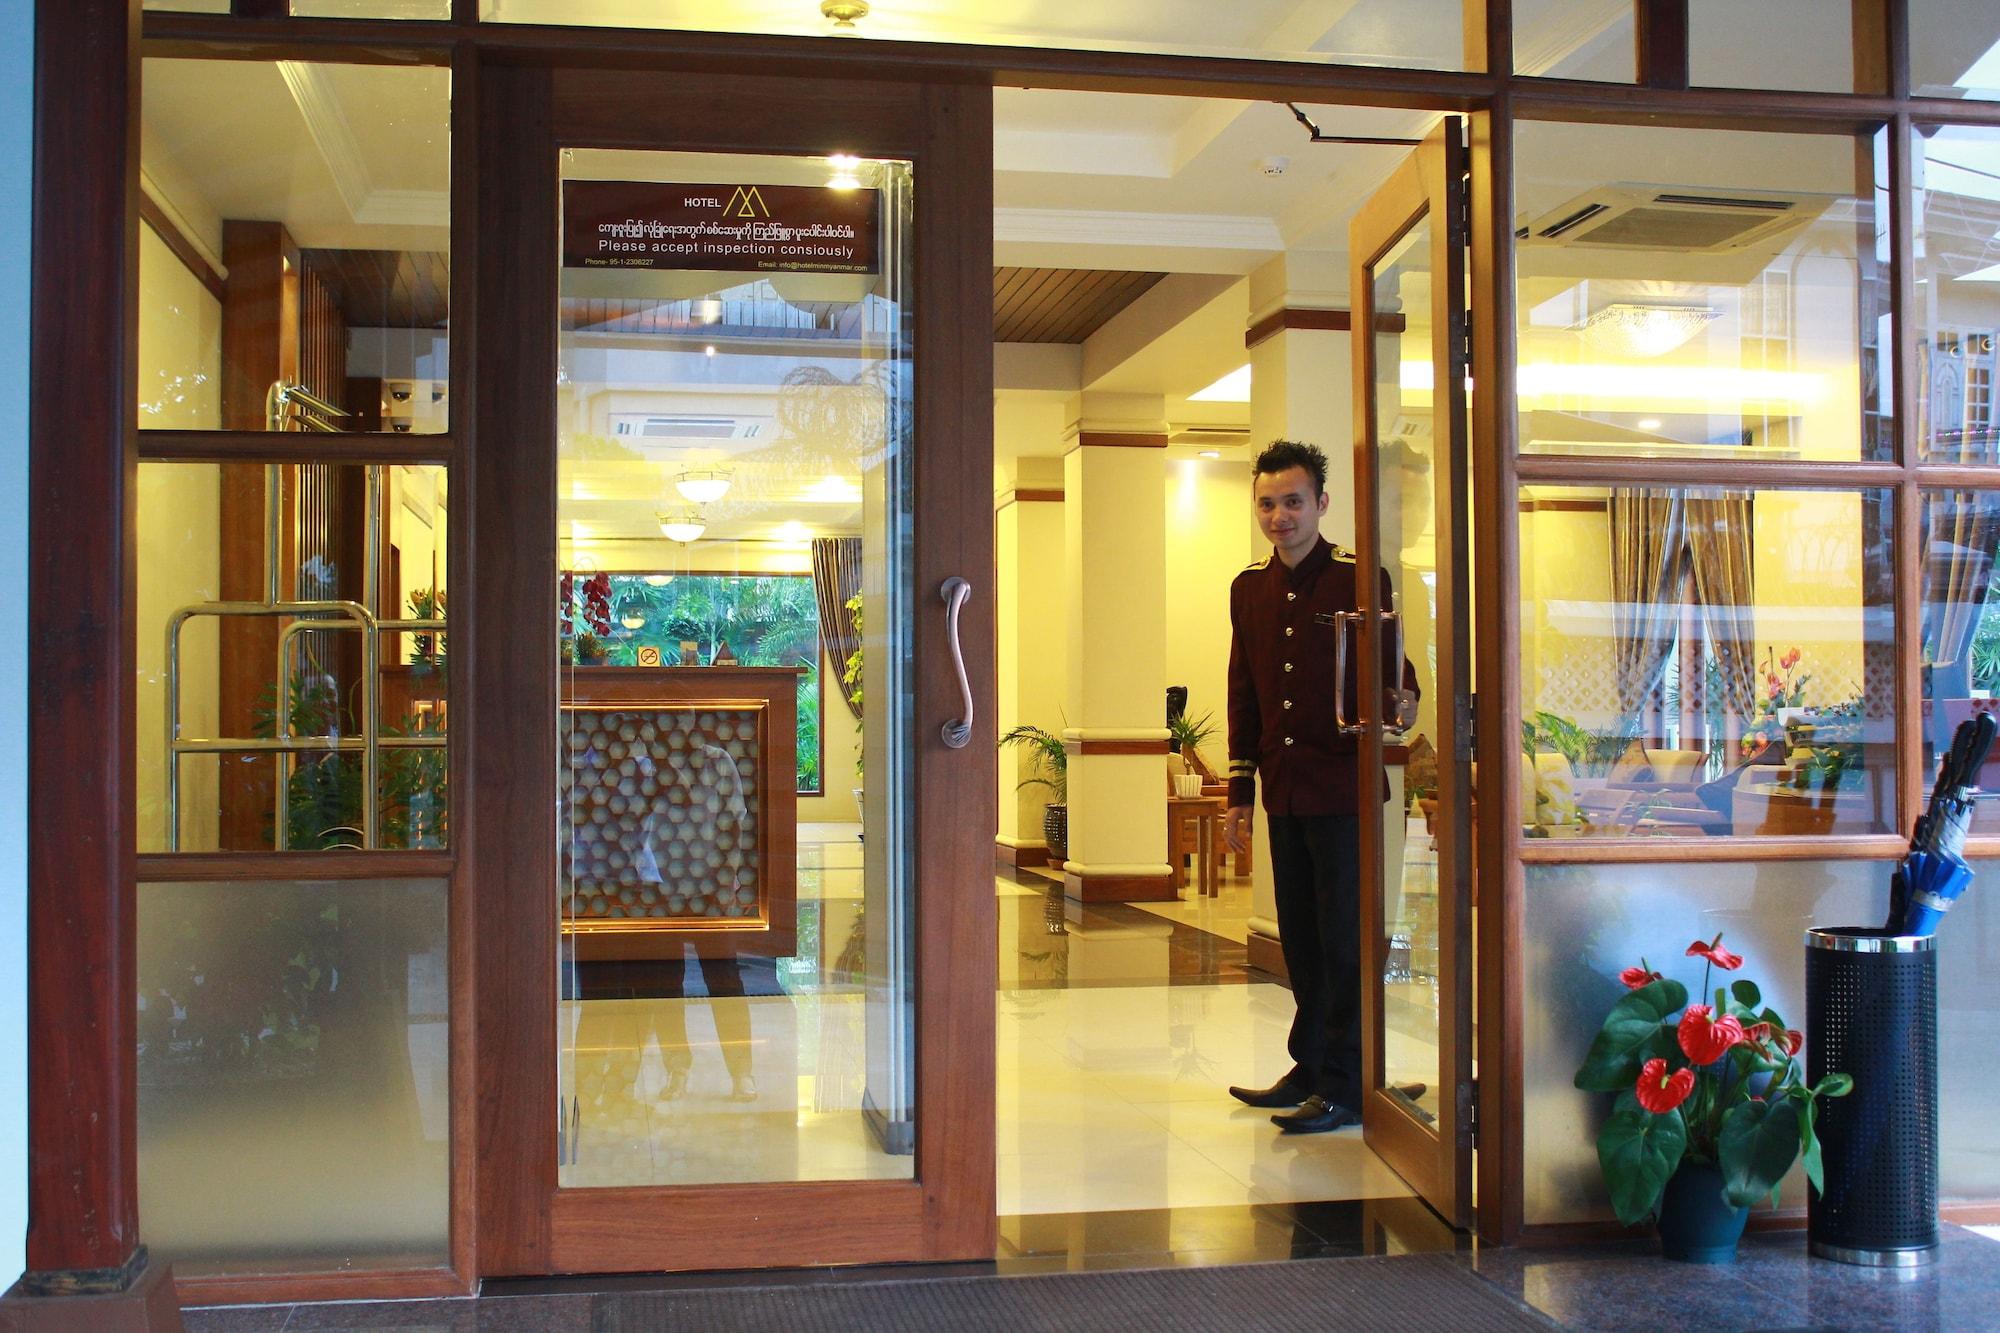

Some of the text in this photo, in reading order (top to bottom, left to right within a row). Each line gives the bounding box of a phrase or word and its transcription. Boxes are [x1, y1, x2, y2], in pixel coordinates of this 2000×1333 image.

[684, 198, 721, 207] HOTEL
[598, 240, 854, 259] Please accept inspection consiously
